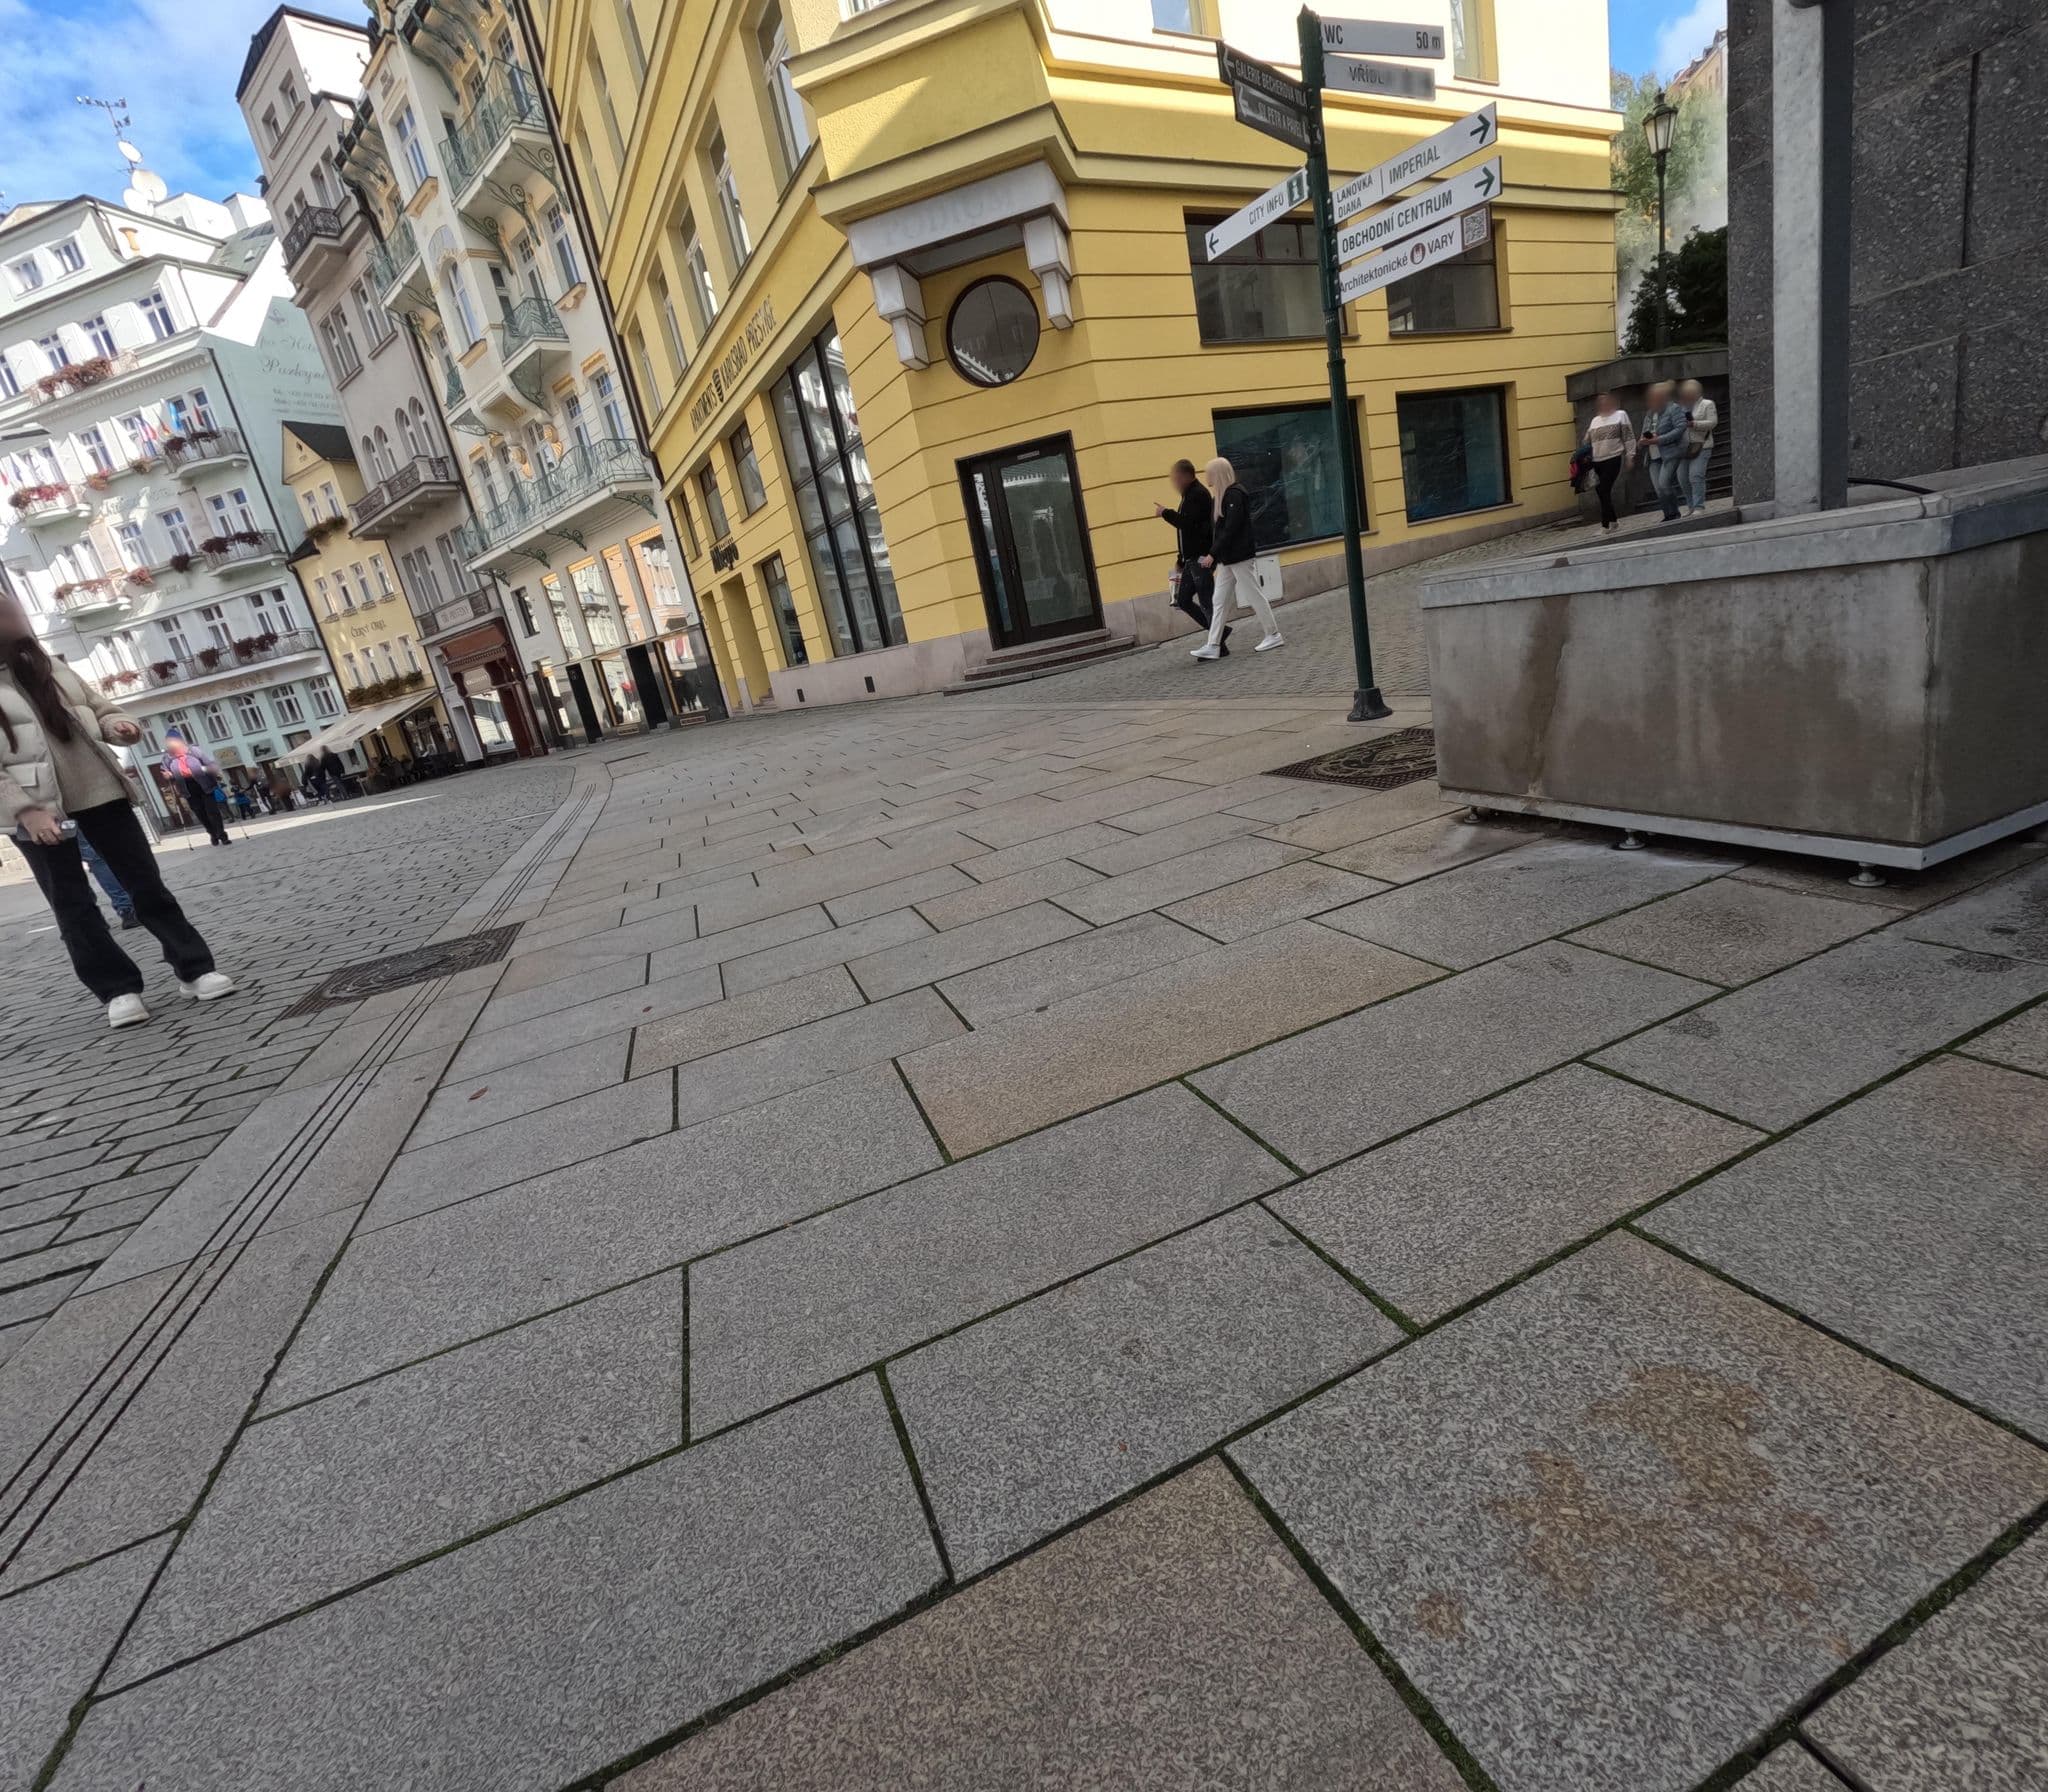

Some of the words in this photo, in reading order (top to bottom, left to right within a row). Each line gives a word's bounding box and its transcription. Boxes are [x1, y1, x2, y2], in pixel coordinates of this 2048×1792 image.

[1324, 24, 1343, 45] WC
[1416, 31, 1429, 49] 50
[1431, 36, 1442, 49] m
[1349, 63, 1392, 86] VŘÍDL
[1336, 174, 1374, 203] LANOVKA
[1389, 145, 1441, 185] IMPERIAL
[1249, 204, 1265, 225] CITY
[1266, 192, 1284, 214] INFO
[1338, 197, 1362, 219] DIANA
[1342, 211, 1394, 253] OBCHODNÍ
[1398, 189, 1453, 229] CENTRUM
[1340, 251, 1409, 293] Architektonické
[1427, 229, 1455, 255] VARY
[720, 335, 748, 391] KARLSBAD
